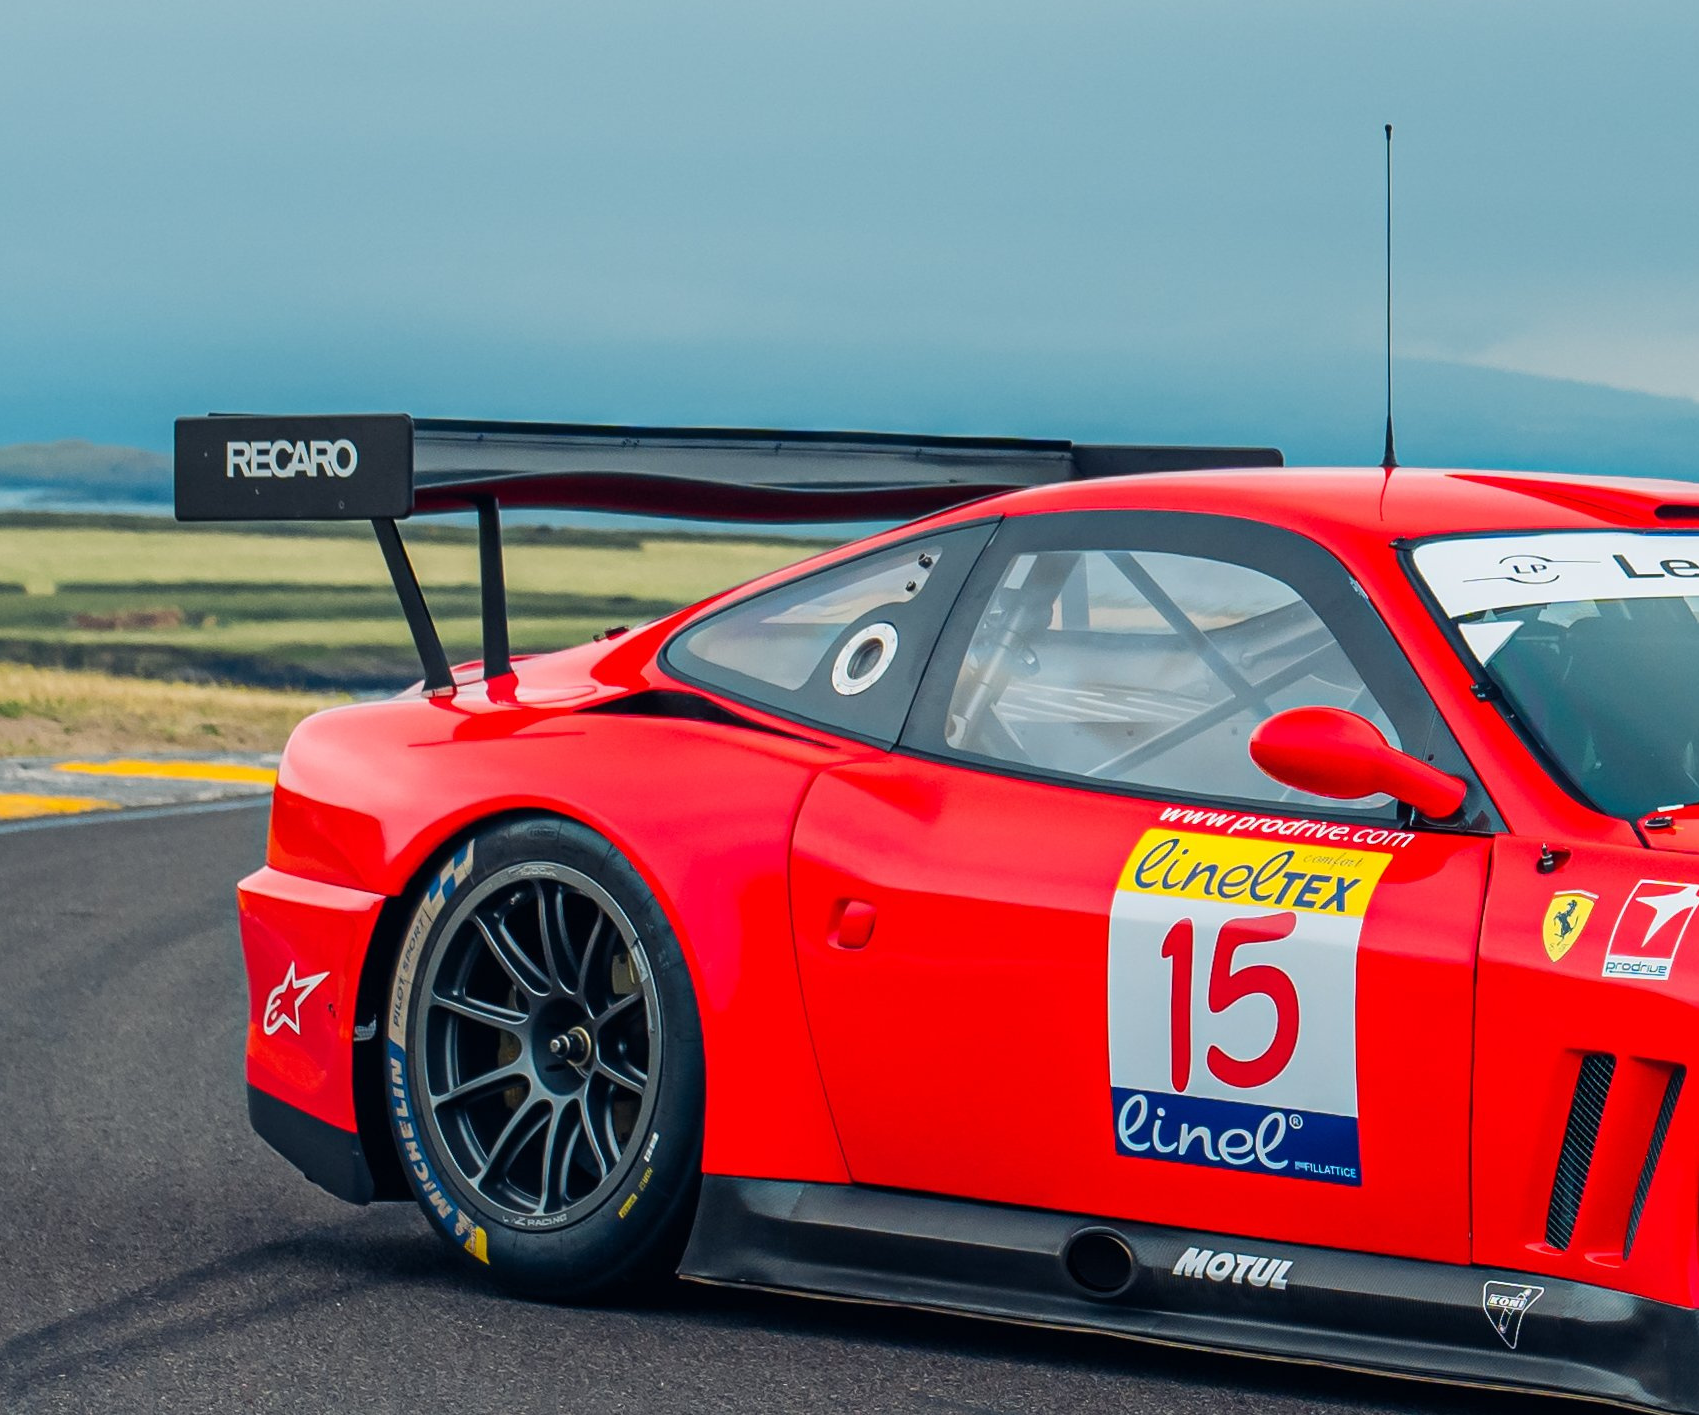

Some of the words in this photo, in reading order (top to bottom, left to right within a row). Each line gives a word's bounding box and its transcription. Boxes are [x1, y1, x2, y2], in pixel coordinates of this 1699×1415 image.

[226, 440, 358, 478] RECARO
[1513, 564, 1547, 574] LP
[1227, 814, 1416, 848] prodrive.com
[393, 977, 406, 1028] PILOT
[402, 916, 425, 973] SPORT
[1606, 961, 1668, 973] prodrive
[1160, 911, 1300, 1094] 15
[390, 1057, 454, 1220] MICHELIN
[1304, 1162, 1358, 1179] FILLATTICE
[527, 1213, 568, 1227] RACING
[1172, 1247, 1294, 1290] MOTUL
[1488, 1295, 1526, 1309] KONI
